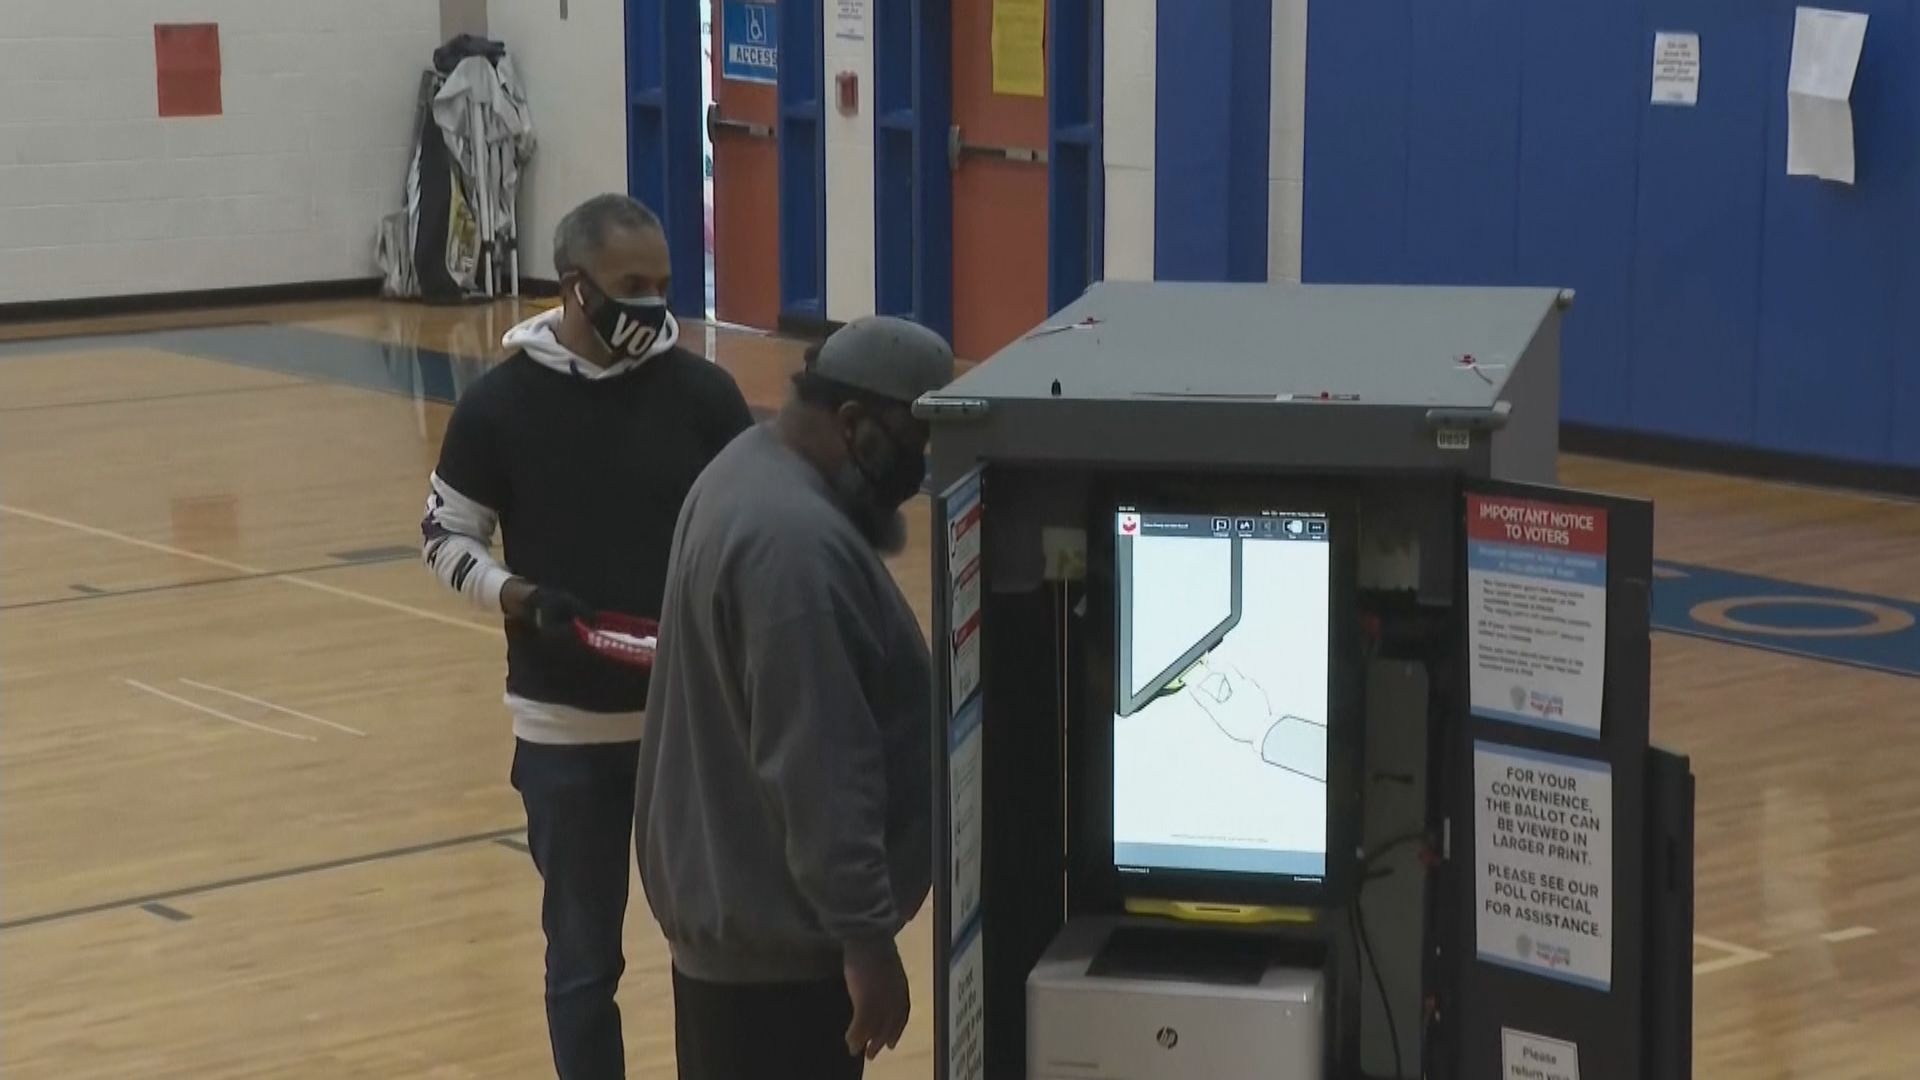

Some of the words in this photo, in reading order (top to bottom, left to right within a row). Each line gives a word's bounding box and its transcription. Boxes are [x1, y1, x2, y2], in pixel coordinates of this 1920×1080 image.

[1479, 503, 1548, 527] IMPORTANT
[1551, 511, 1594, 531] NOTICE
[1505, 523, 1522, 540] TO
[1525, 527, 1569, 545] VOTERS
[1506, 766, 1533, 783] FOR
[1538, 772, 1576, 791] YOUR
[1492, 782, 1592, 813] CONVENIENCE,
[1486, 798, 1510, 815] THE
[1515, 802, 1566, 824] BALLOT
[1570, 814, 1600, 831] CAN
[1497, 818, 1513, 833] BE
[1517, 821, 1569, 842] VIEWED
[1573, 832, 1587, 847] IN
[1493, 834, 1544, 855] LARGER
[1548, 845, 1592, 865] PRINT.
[1488, 863, 1535, 885] PLEASE
[1540, 874, 1564, 891] SEE
[1568, 880, 1599, 899] OUR
[1495, 882, 1526, 901] POLL
[1531, 889, 1592, 915] OFFICIAL
[1486, 900, 1511, 917] FOR
[1515, 907, 1602, 938] ASSISTANCE.
[1523, 1045, 1557, 1065] Please
